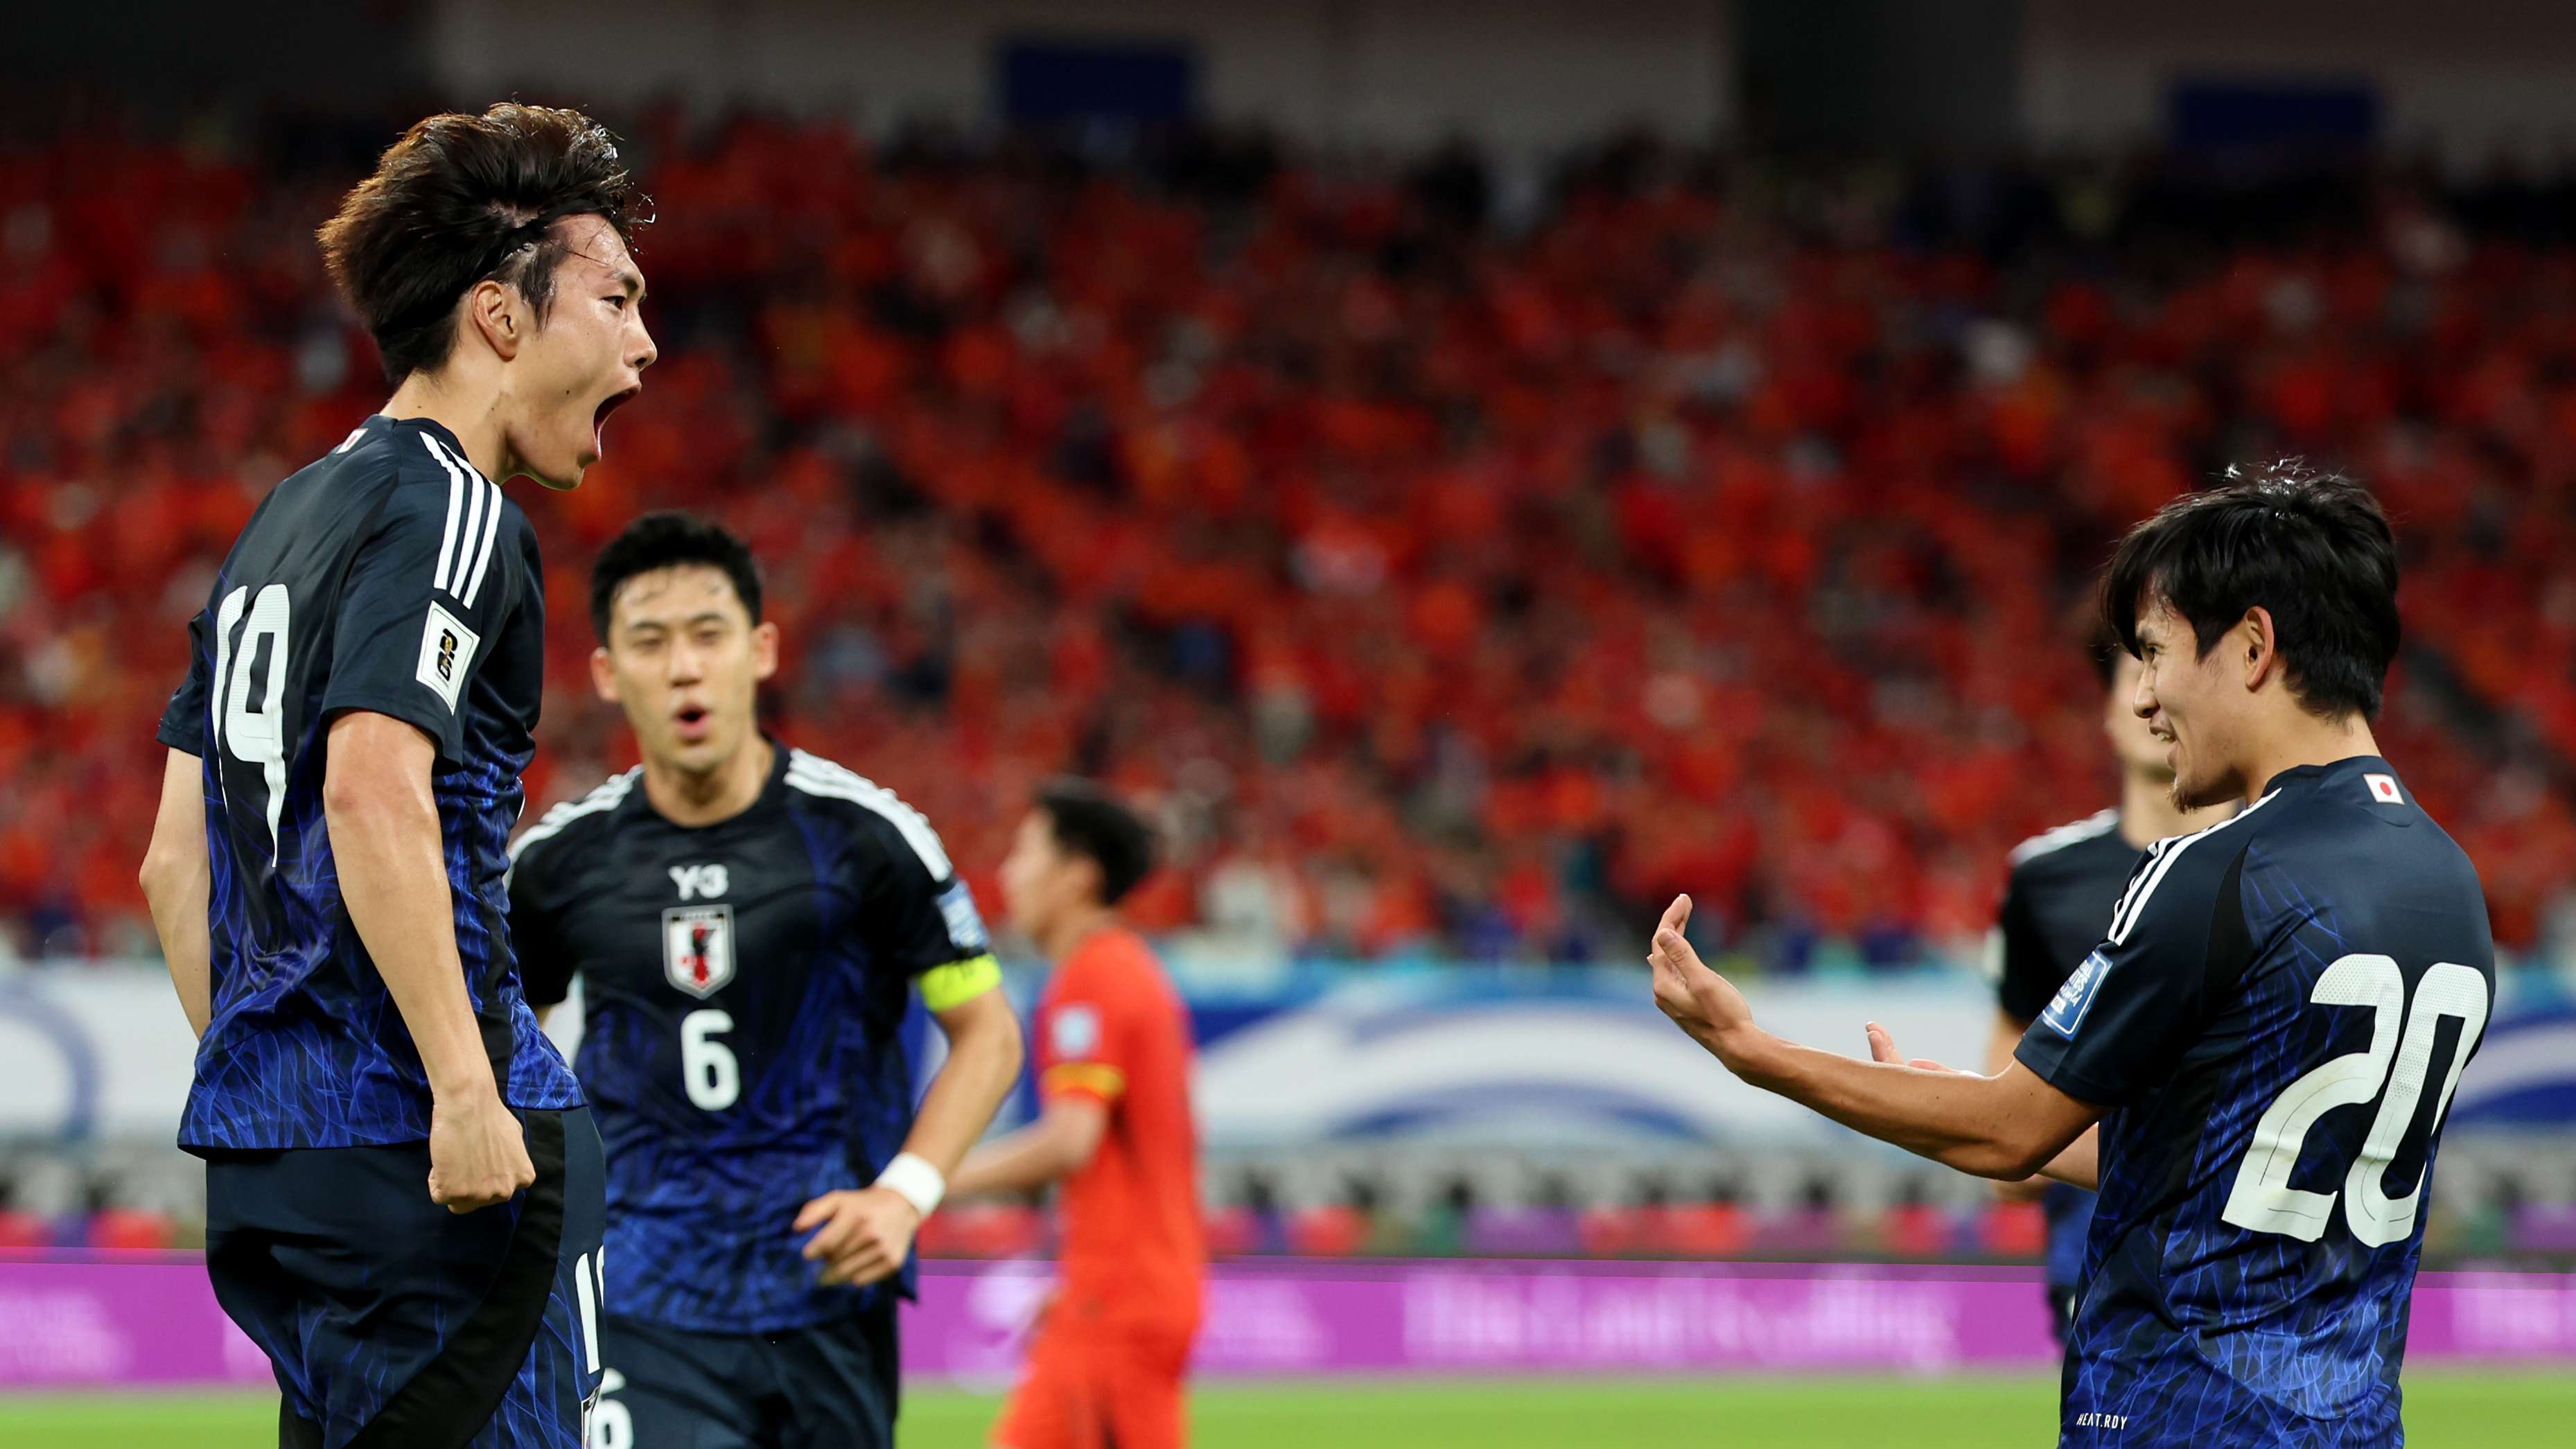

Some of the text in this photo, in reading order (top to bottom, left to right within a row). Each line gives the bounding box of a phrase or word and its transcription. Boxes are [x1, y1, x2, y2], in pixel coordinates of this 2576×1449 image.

[211, 583, 290, 868] 19
[681, 1009, 740, 1112] 6
[2221, 954, 2488, 1248] 20
[575, 1245, 604, 1375] 1
[2076, 1412, 2128, 1430] HEAT.RDY
